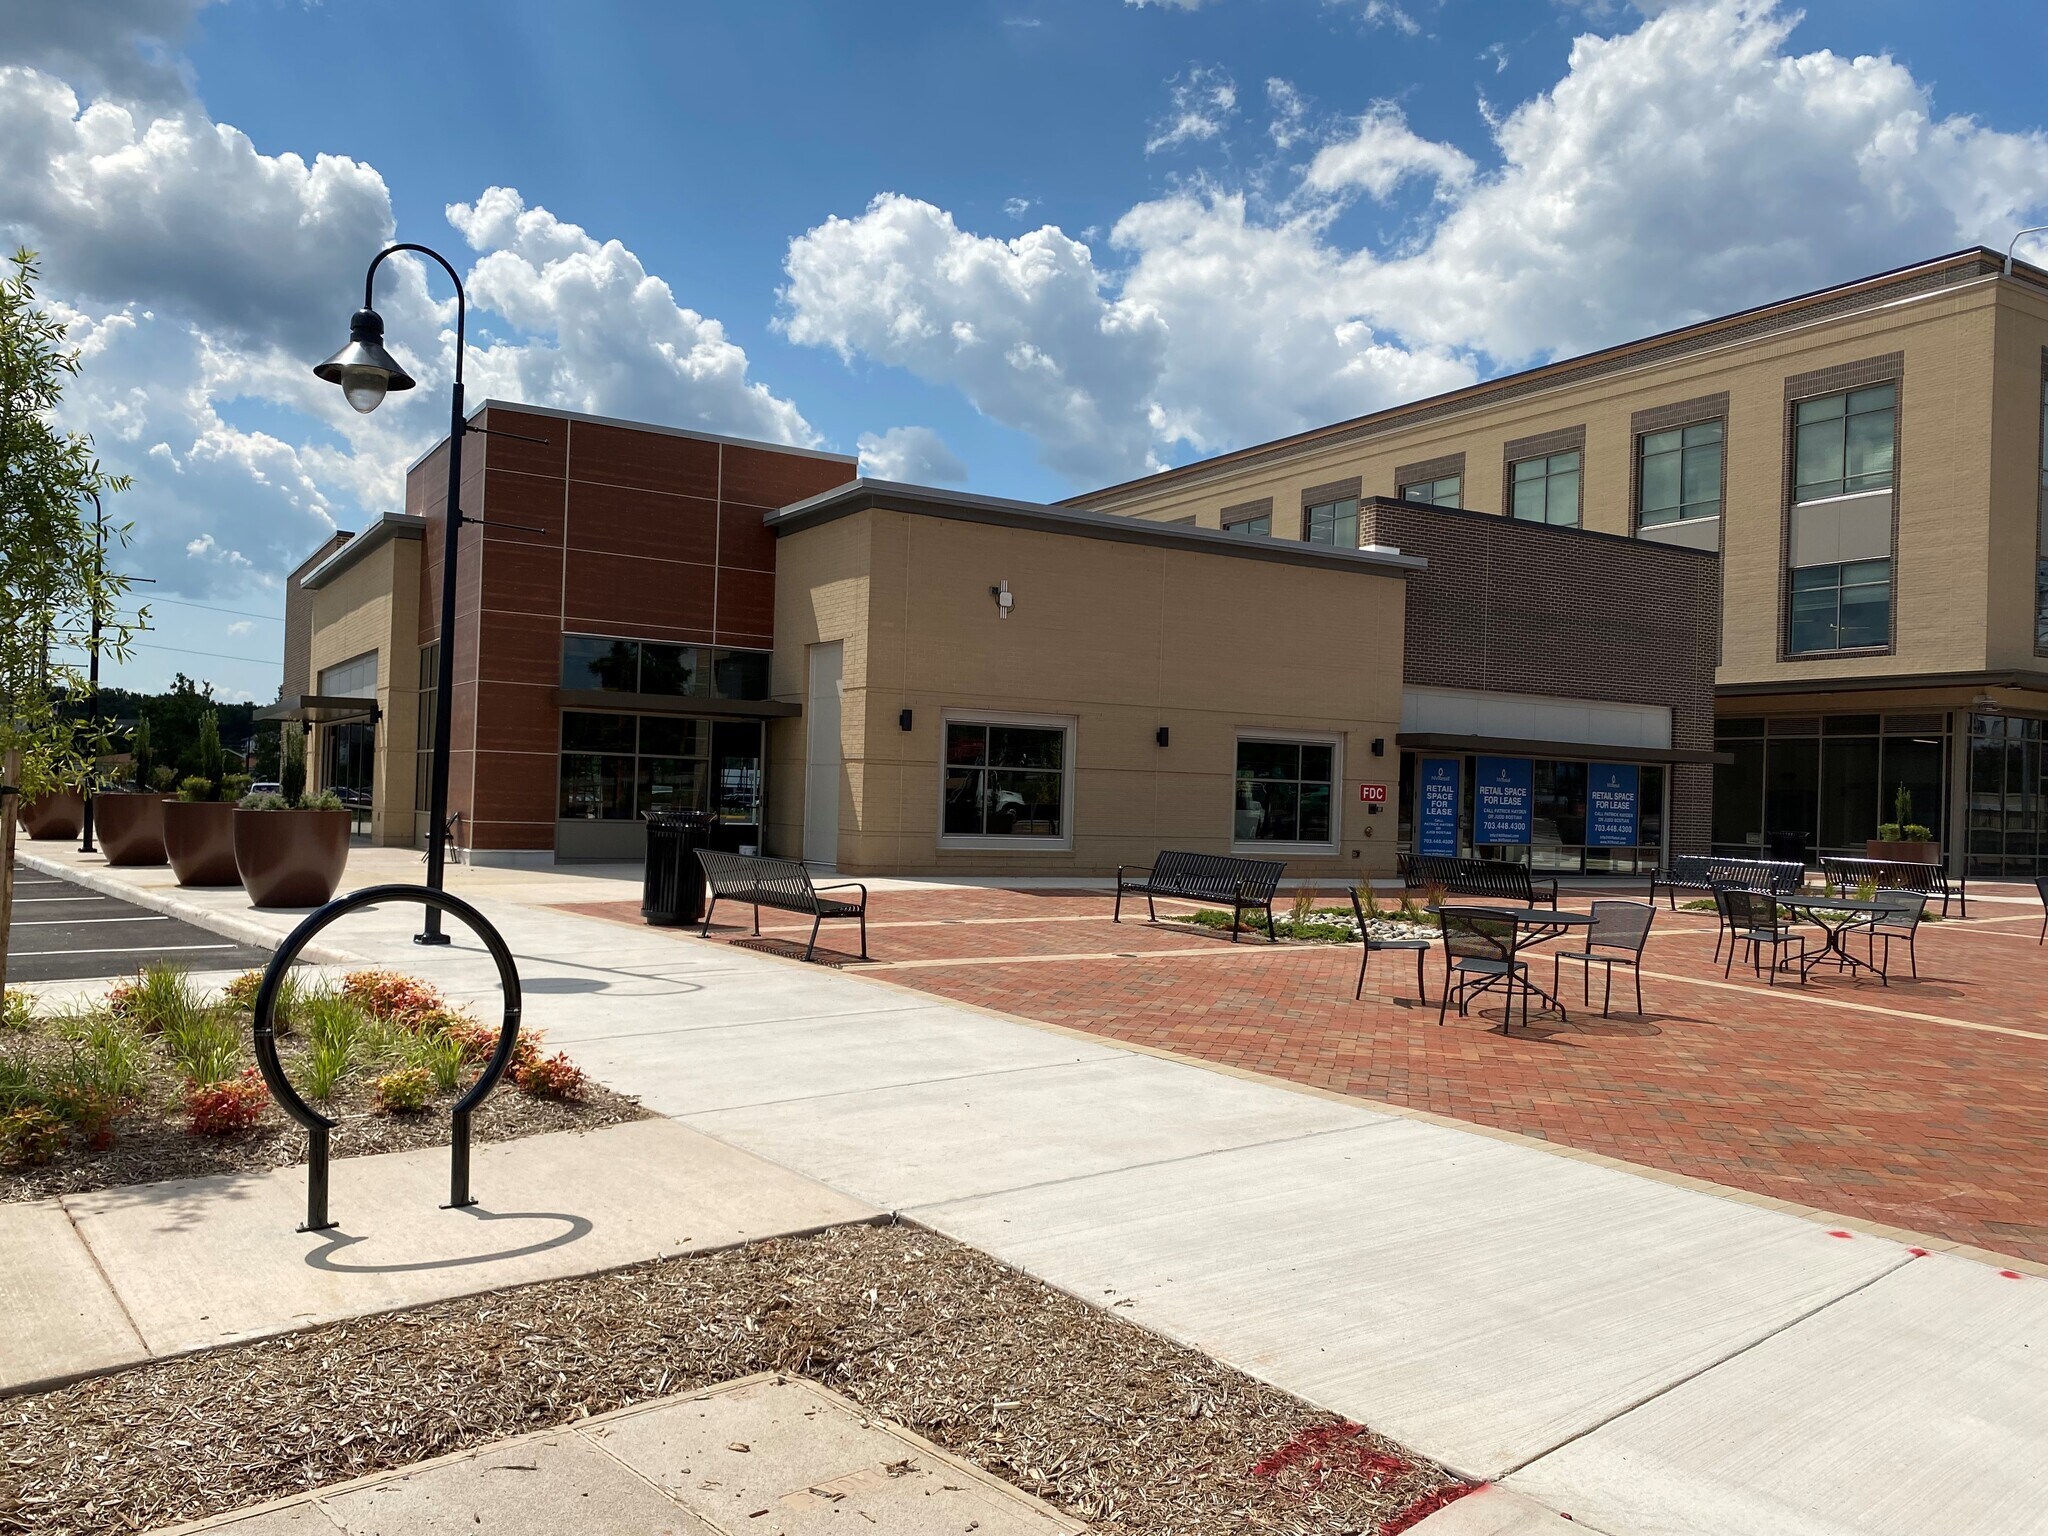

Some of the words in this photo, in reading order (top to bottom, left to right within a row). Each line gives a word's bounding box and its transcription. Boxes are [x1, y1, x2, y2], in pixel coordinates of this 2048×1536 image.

[1363, 787, 1383, 799] FDC
[1426, 785, 1454, 793] RETAIL
[1479, 786, 1503, 795] RETAIL
[1504, 787, 1527, 797] SPACE
[1483, 796, 1498, 805] FOR
[1500, 797, 1522, 806] LEASE
[1592, 791, 1613, 800] RETAIL
[1614, 792, 1635, 801] SPACE
[1431, 800, 1448, 808] FOR
[1595, 800, 1609, 809] FOR
[1610, 801, 1630, 810] LEASE
[1483, 821, 1526, 830] 703.448.4300
[1594, 824, 1632, 833] 703.448.4300
